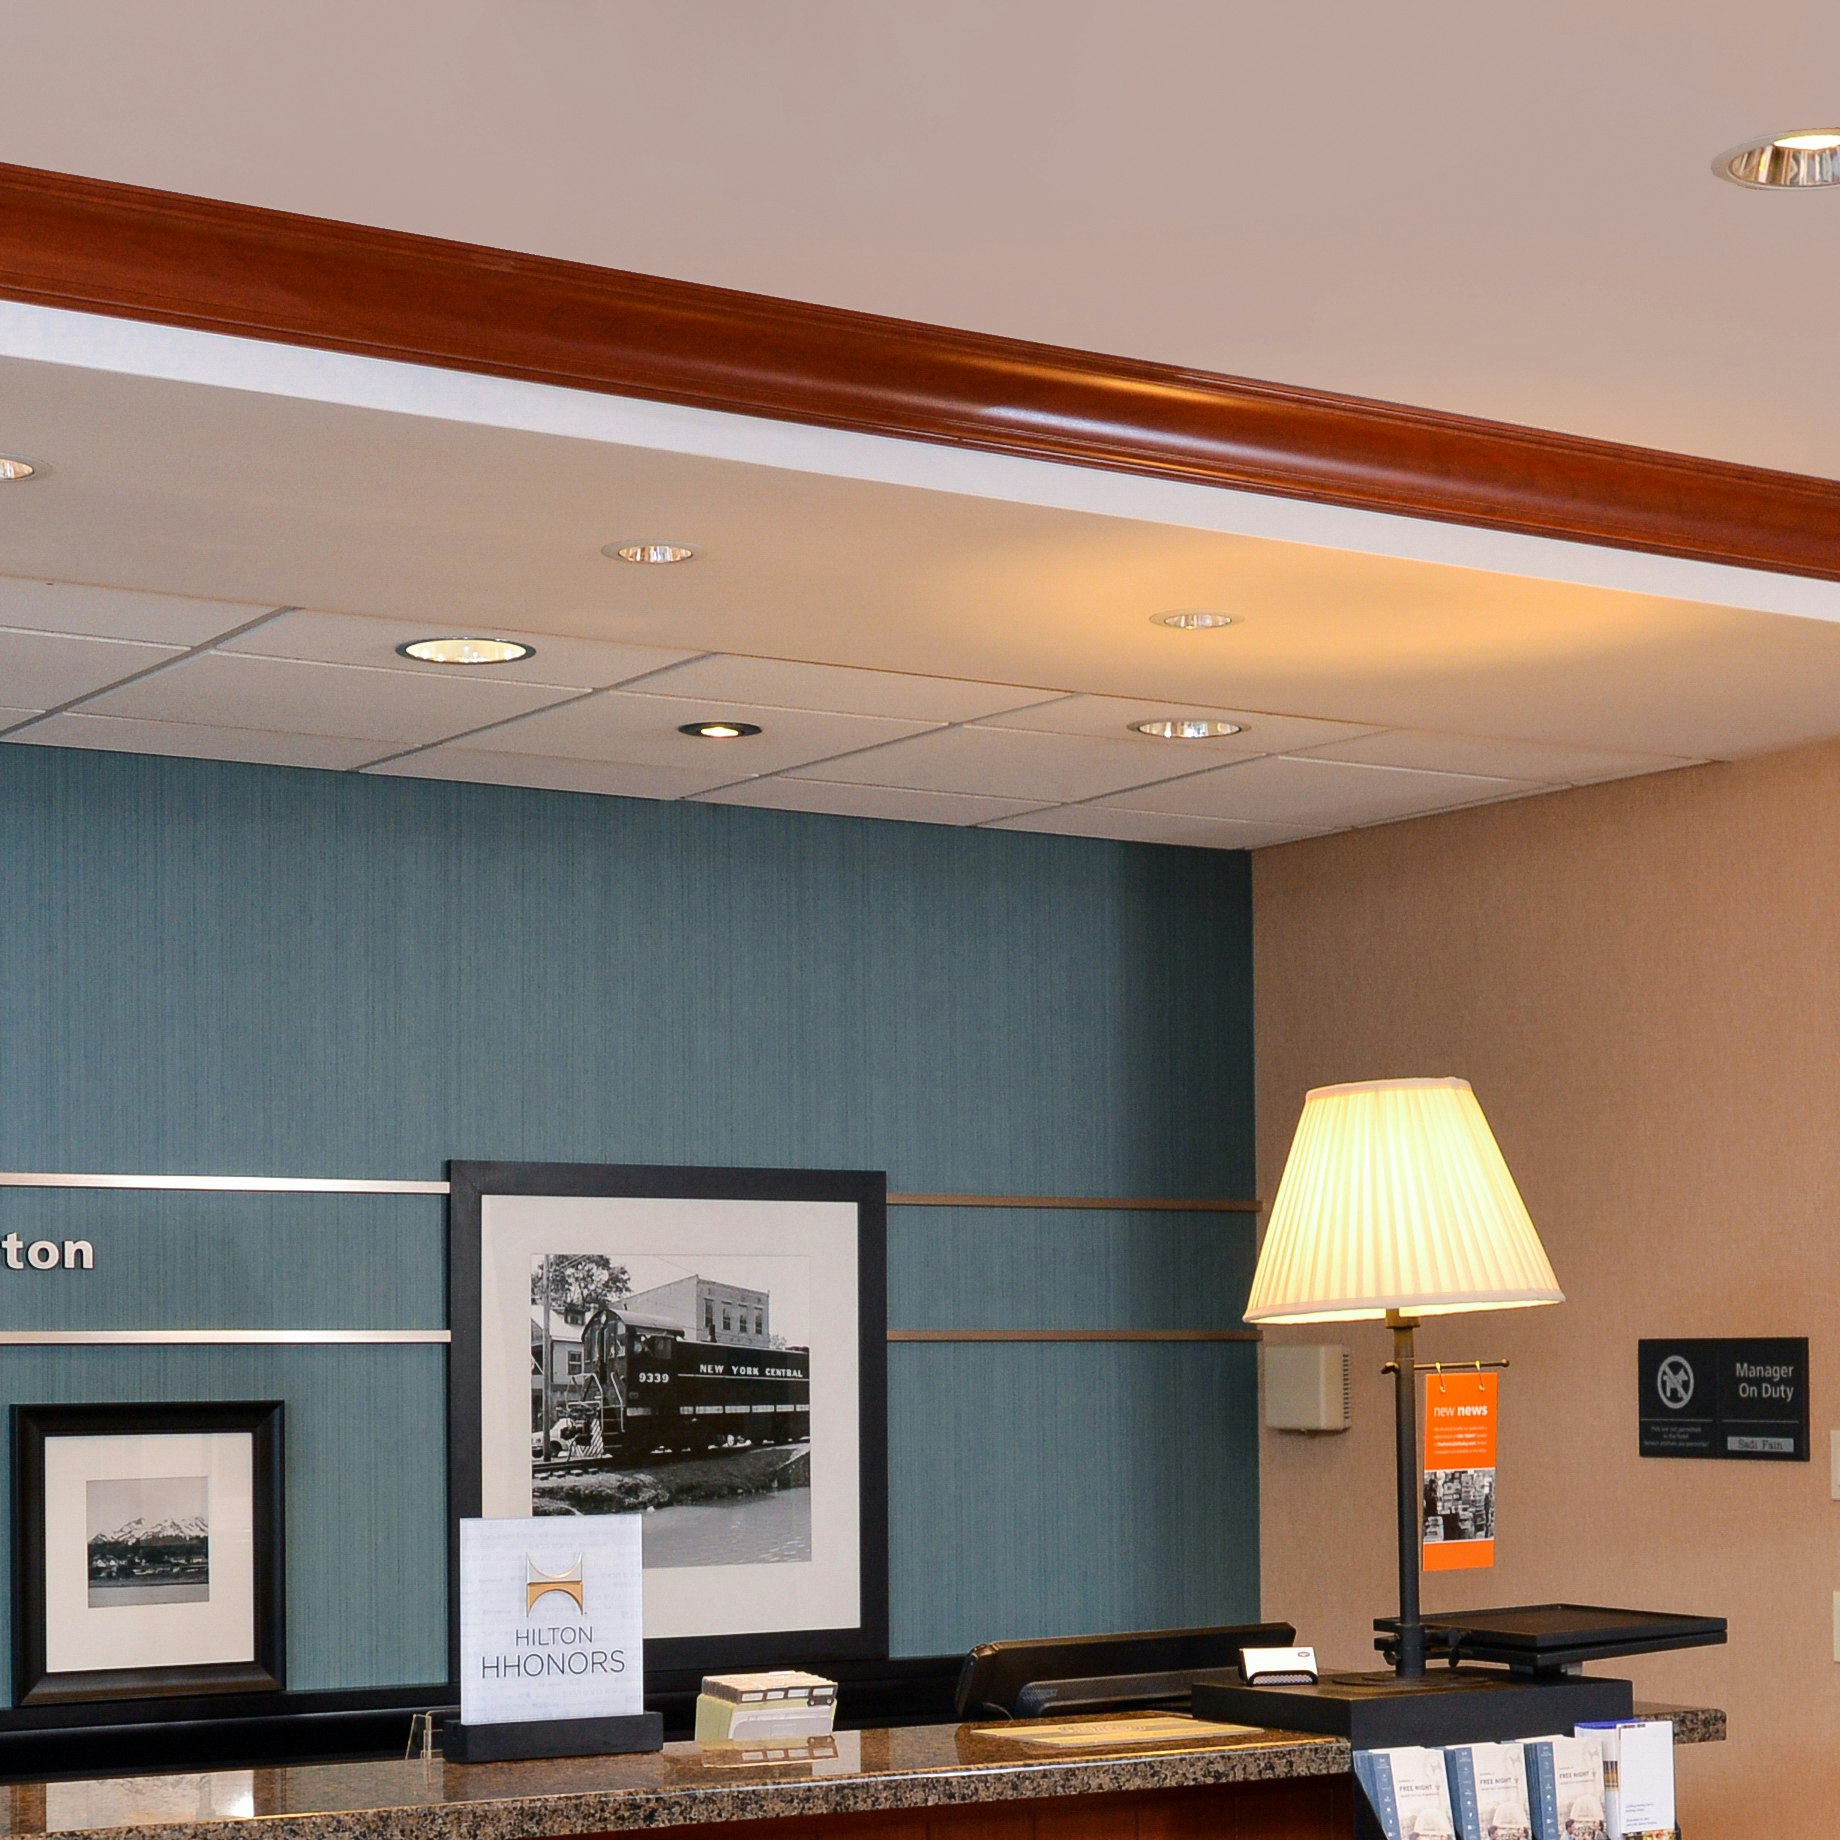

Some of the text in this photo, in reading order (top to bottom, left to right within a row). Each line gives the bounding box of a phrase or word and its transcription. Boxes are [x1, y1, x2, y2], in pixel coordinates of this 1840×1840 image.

[639, 1373, 669, 1383] 9339
[700, 1364, 803, 1378] NEW YORK CENTRAL
[1736, 1363, 1794, 1381] Manager
[1739, 1382, 1794, 1402] On Duty
[1434, 1405, 1488, 1417] new news
[516, 1626, 593, 1646] HILTON
[482, 1649, 625, 1679] HHONORS
